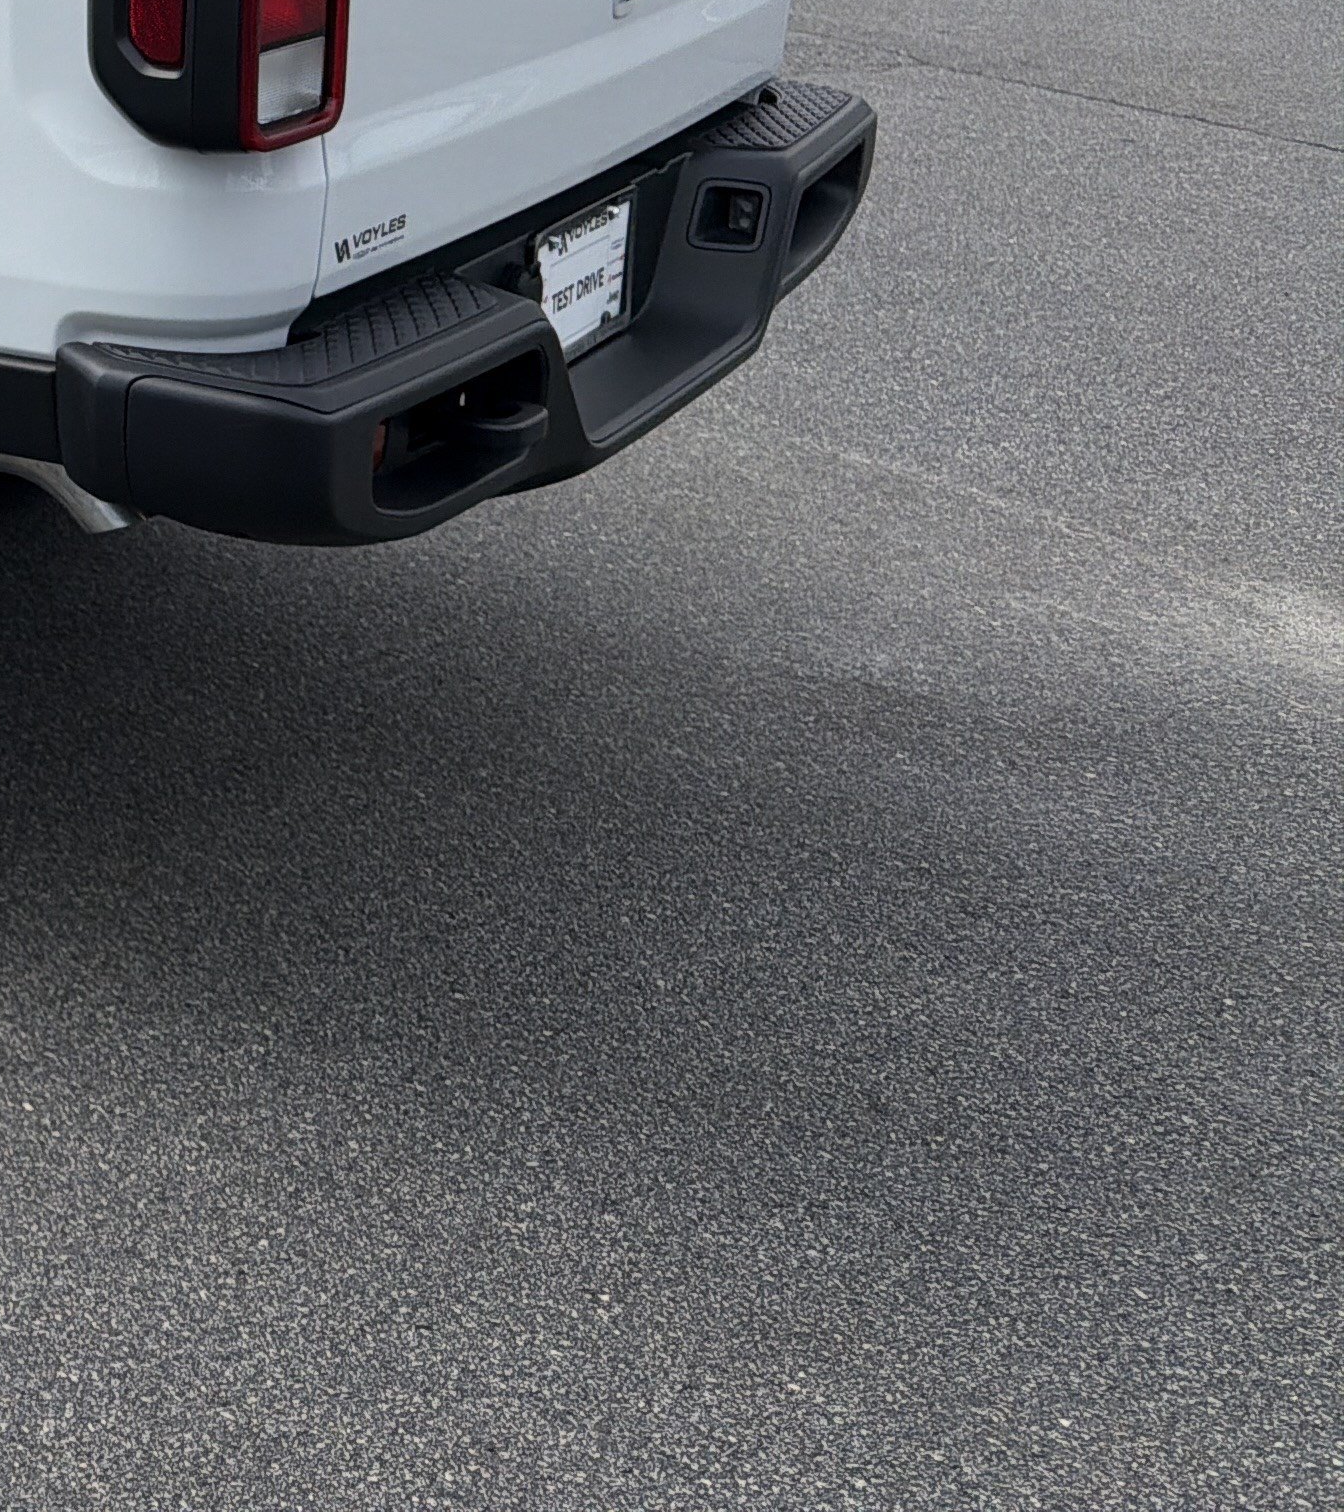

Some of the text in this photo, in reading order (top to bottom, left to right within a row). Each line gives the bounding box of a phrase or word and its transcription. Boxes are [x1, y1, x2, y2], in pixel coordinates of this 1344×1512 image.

[352, 213, 407, 249] VOYLES
[566, 210, 608, 244] VOYLES
[552, 283, 575, 315] TEST
[576, 267, 605, 301] DRIVE
